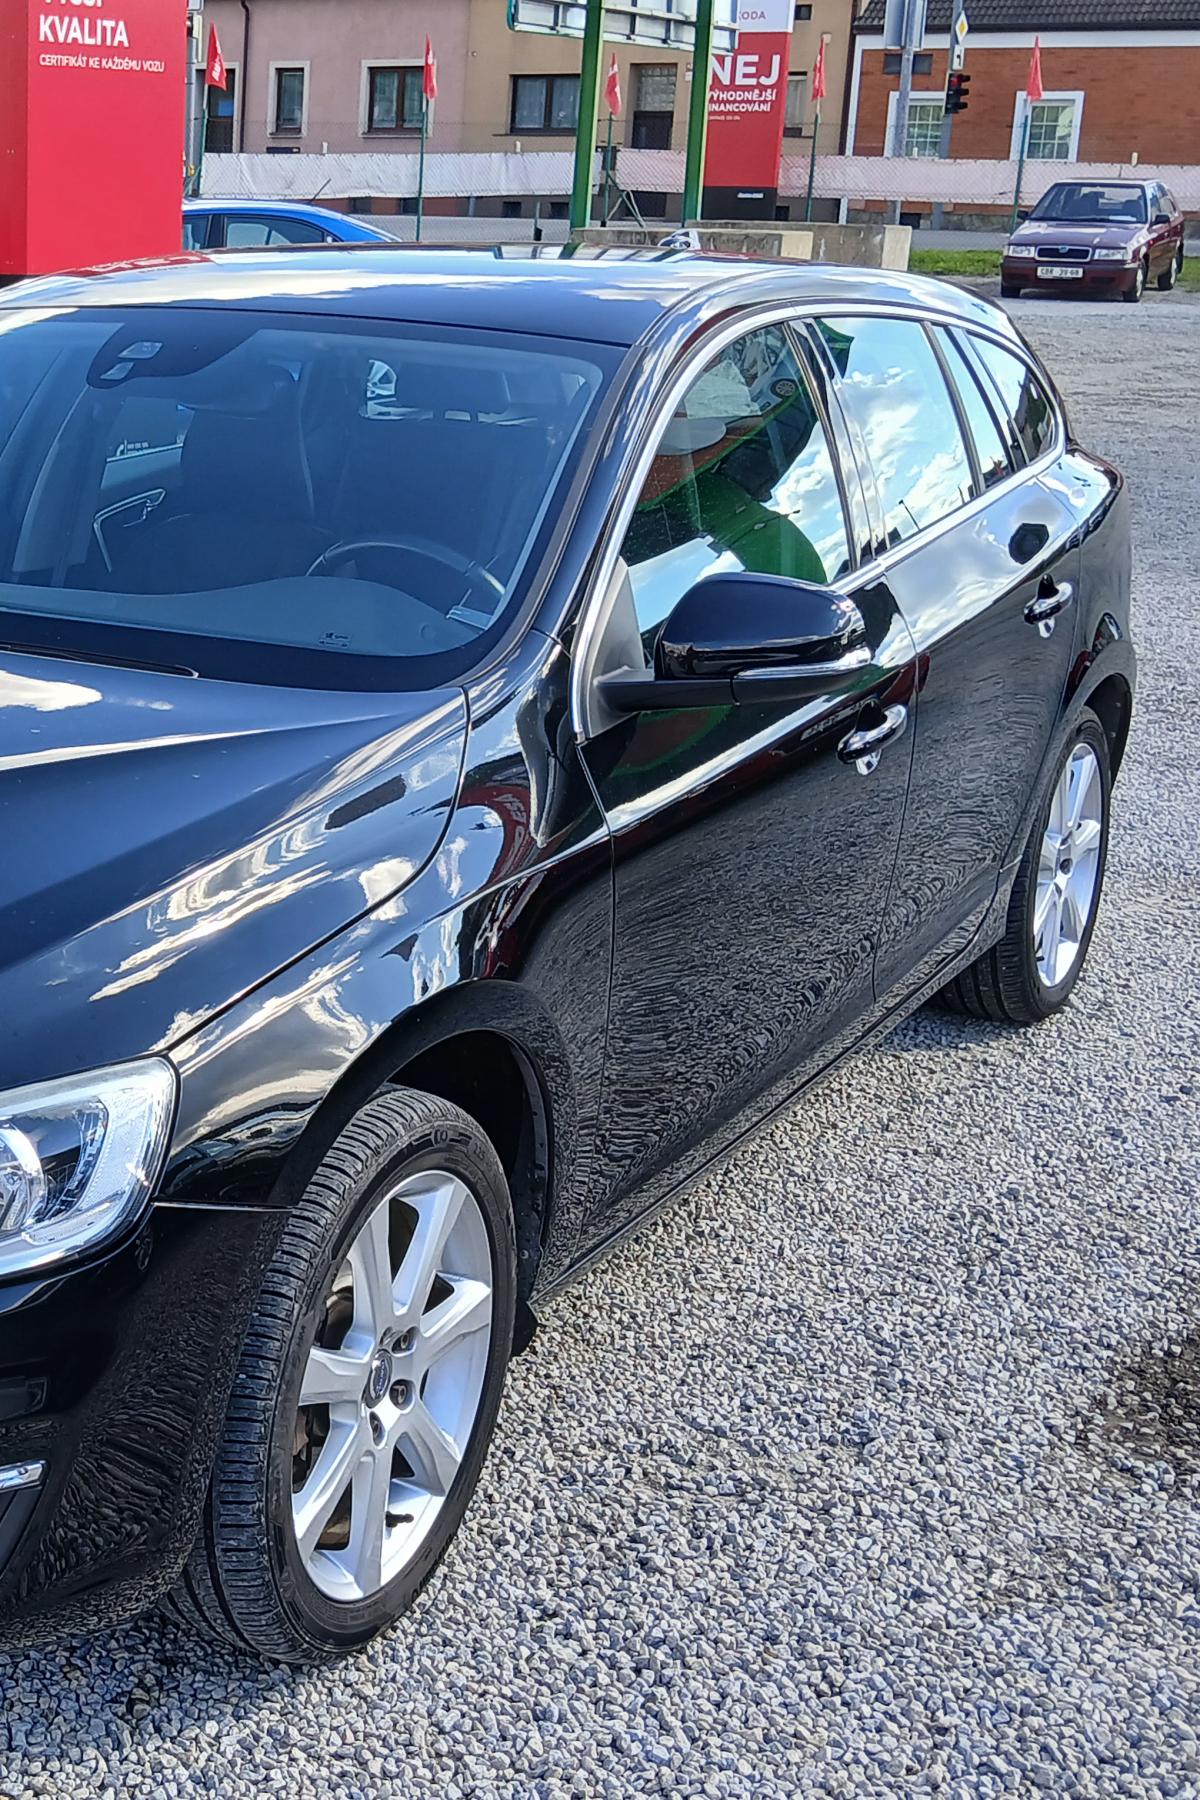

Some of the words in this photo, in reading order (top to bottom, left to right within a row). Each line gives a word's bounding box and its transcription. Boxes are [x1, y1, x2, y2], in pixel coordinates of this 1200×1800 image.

[739, 11, 766, 21] ODA
[39, 14, 129, 47] KVALITA
[39, 54, 87, 68] CERTIFIKÁT
[89, 57, 100, 68] KE
[101, 56, 141, 71] KAŽDÉMU
[142, 60, 165, 73] VOZU
[711, 54, 781, 86] NEJ
[708, 101, 771, 112] INANCOVÁNÍ
